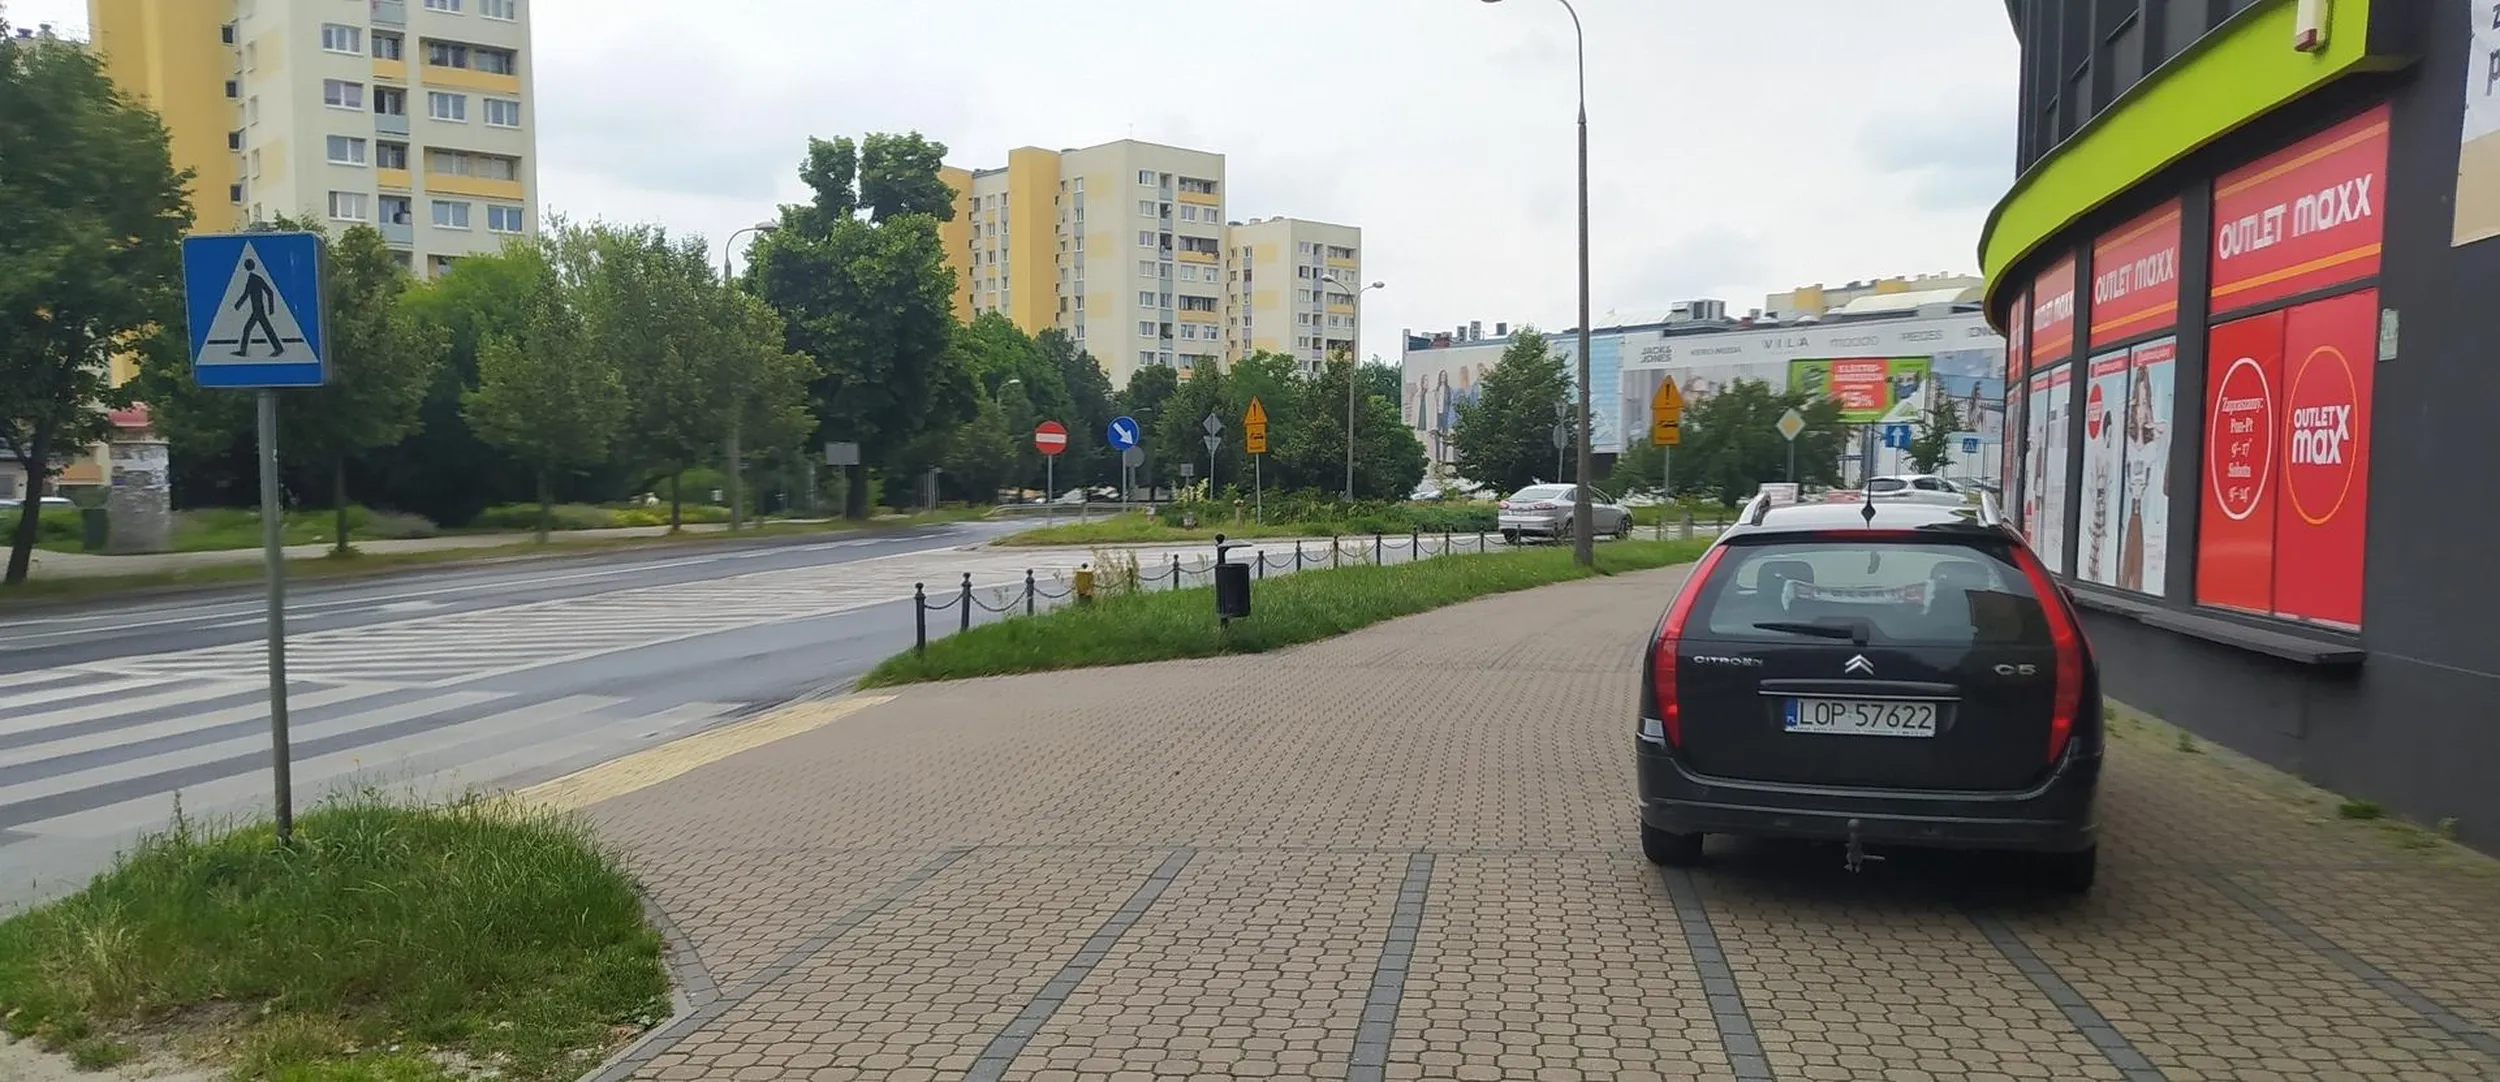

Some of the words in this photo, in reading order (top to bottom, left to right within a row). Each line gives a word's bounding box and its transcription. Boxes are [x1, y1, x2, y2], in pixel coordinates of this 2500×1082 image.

[2219, 203, 2287, 260] OUTLET
[2094, 263, 2132, 305] OUTLET
[2293, 405, 2335, 429] OUTLET
[1994, 663, 2037, 676] C5
[1799, 702, 1846, 726] LOP
[1855, 703, 1933, 730] 57622
